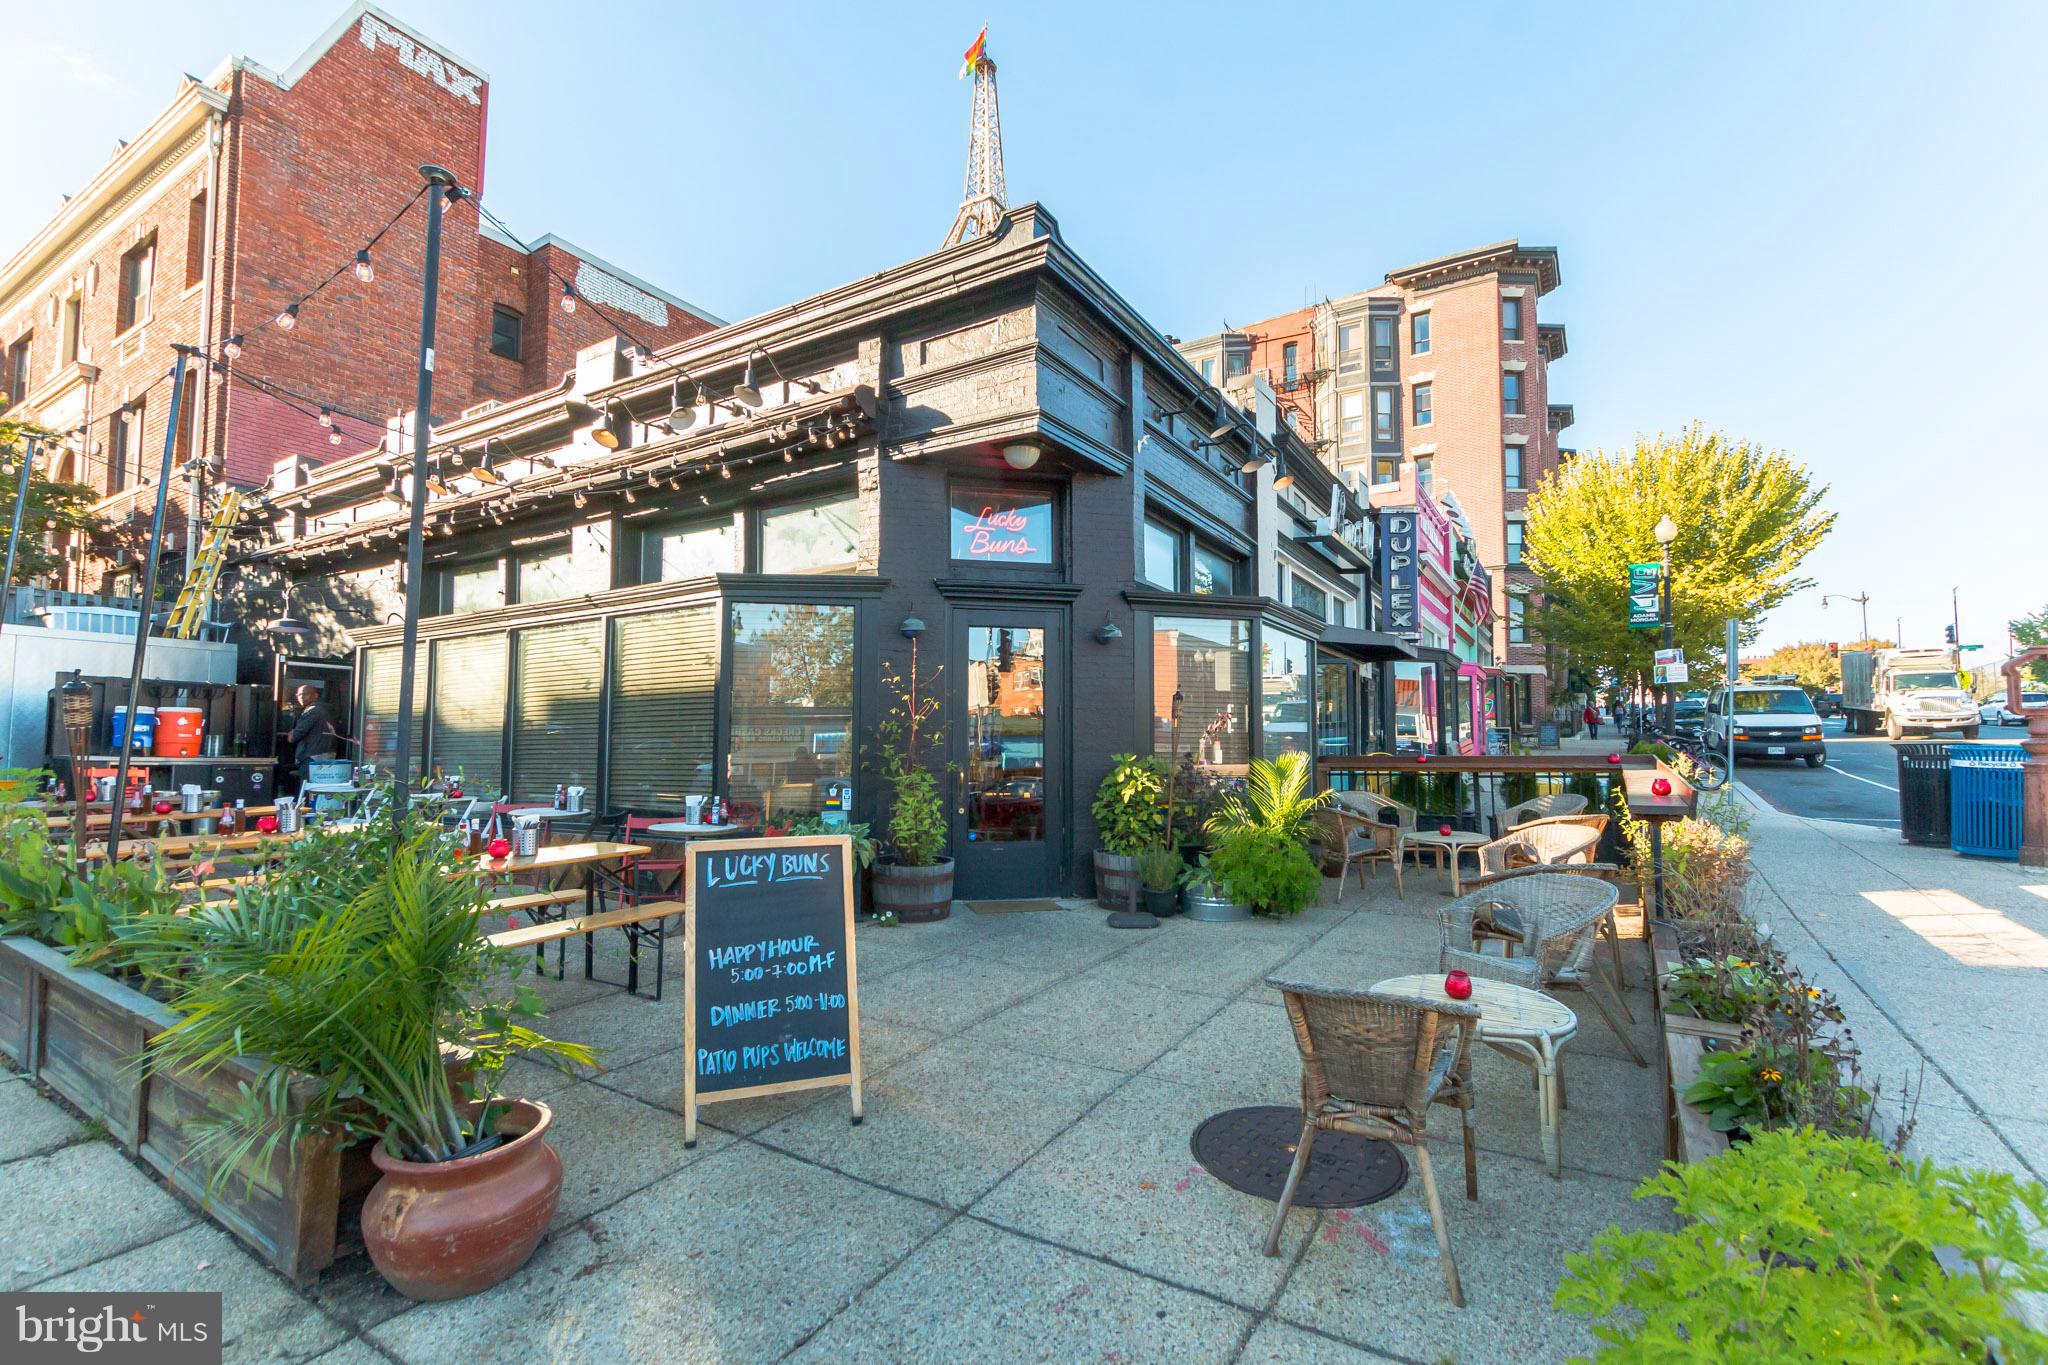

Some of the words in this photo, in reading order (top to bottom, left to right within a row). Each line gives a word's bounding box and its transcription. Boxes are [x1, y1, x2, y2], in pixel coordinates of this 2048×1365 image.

[964, 506, 1027, 532] Lucky
[970, 531, 1037, 554] Buns
[1390, 516, 1412, 627] DUPLEX
[707, 853, 776, 887] LUCKY
[782, 852, 830, 876] BUNS
[708, 943, 767, 969] HAPPY
[767, 935, 819, 958] HOUR
[710, 998, 781, 1027] DINNER
[697, 1048, 737, 1075] PATIO
[743, 1042, 780, 1069] PUPS
[784, 1038, 846, 1063] WELCOME
